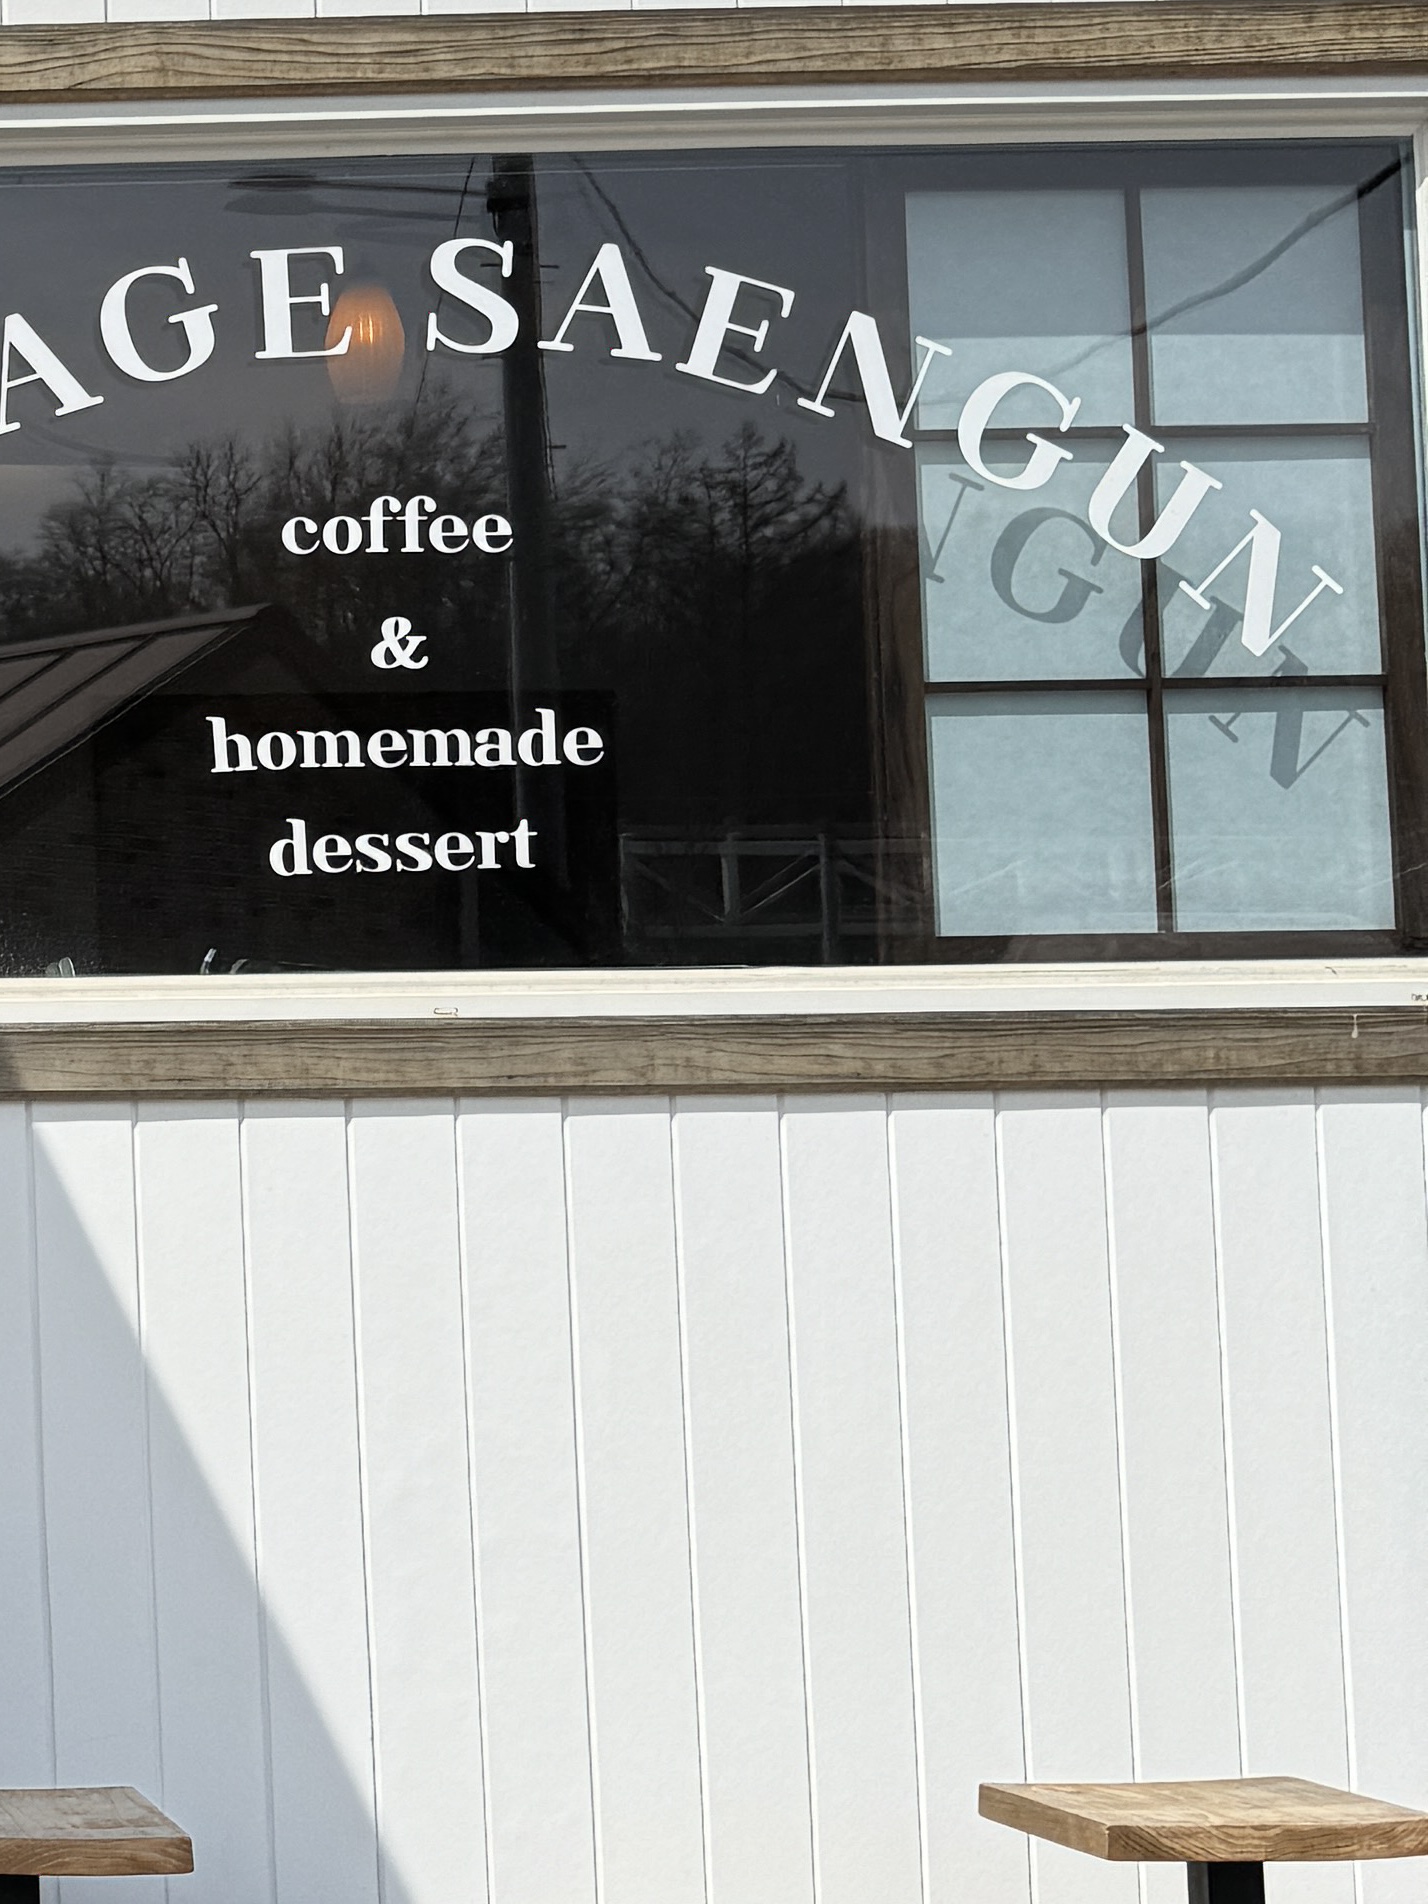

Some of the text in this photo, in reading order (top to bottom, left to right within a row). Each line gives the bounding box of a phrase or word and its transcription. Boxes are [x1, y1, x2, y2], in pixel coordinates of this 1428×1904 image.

[425, 237, 1345, 658] SAENGUN
[280, 494, 515, 556] coffee
[370, 615, 430, 670] &
[205, 708, 605, 774] homemade
[268, 818, 539, 876] dessert
